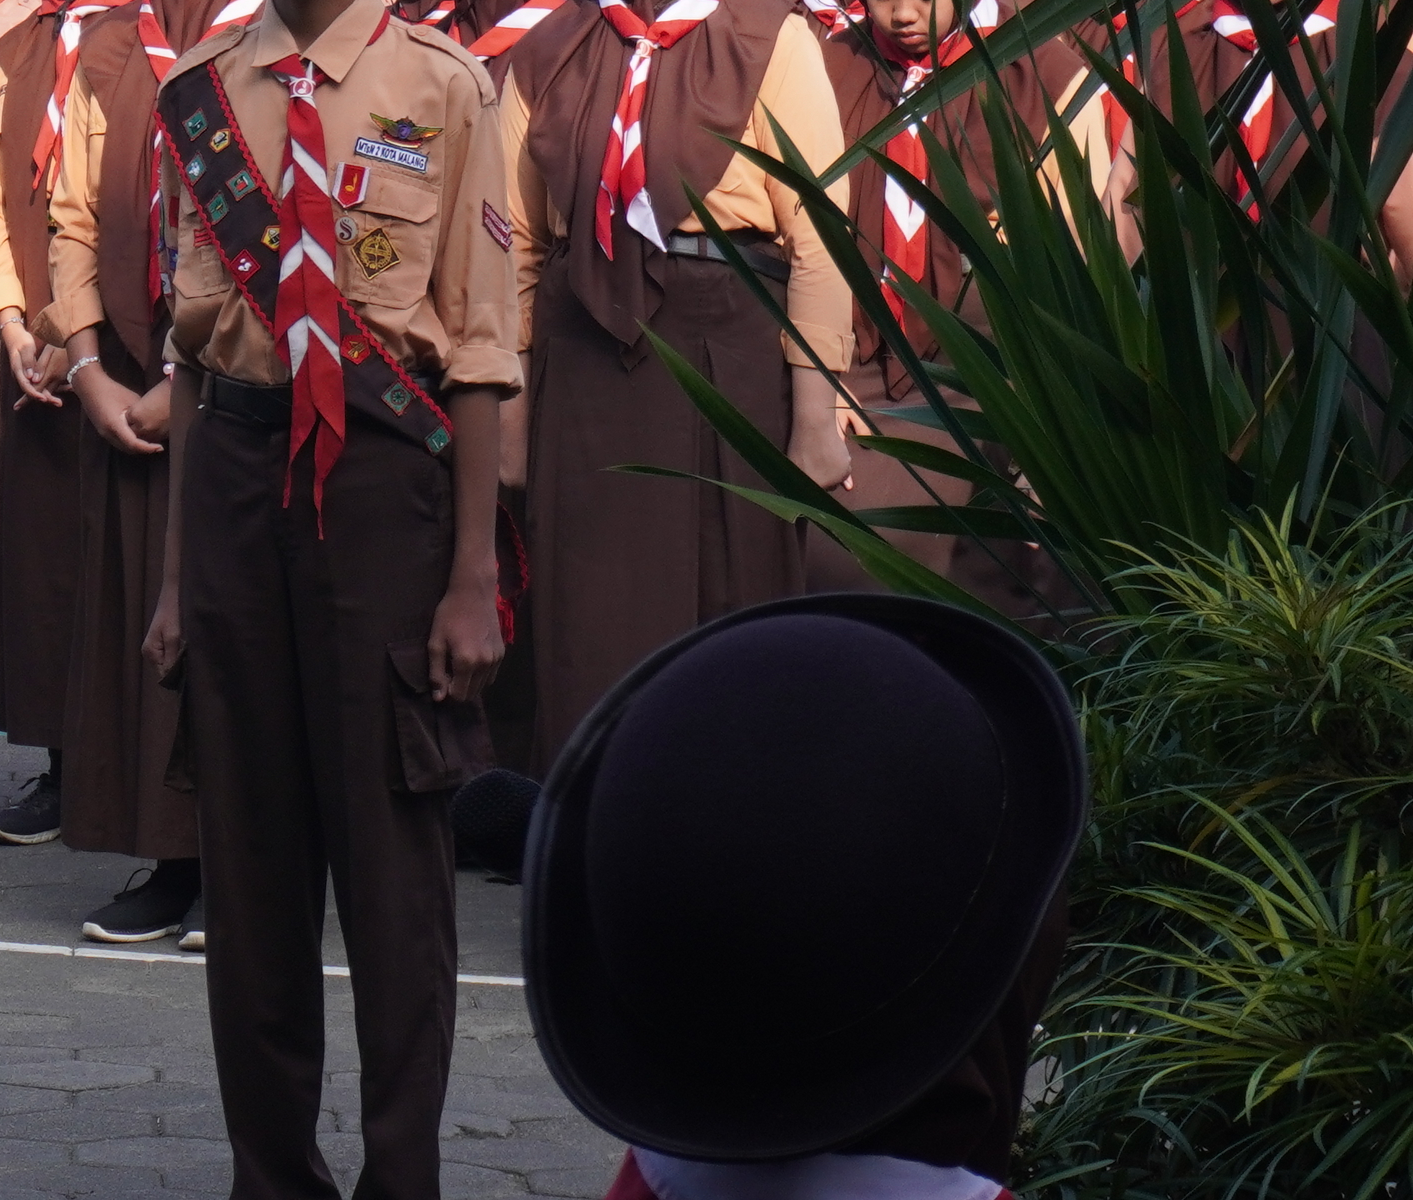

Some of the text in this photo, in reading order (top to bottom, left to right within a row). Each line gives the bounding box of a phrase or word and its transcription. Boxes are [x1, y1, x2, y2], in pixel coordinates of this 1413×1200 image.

[375, 146, 381, 156] 2
[381, 147, 396, 161] KOTA
[398, 152, 425, 169] MALANG
